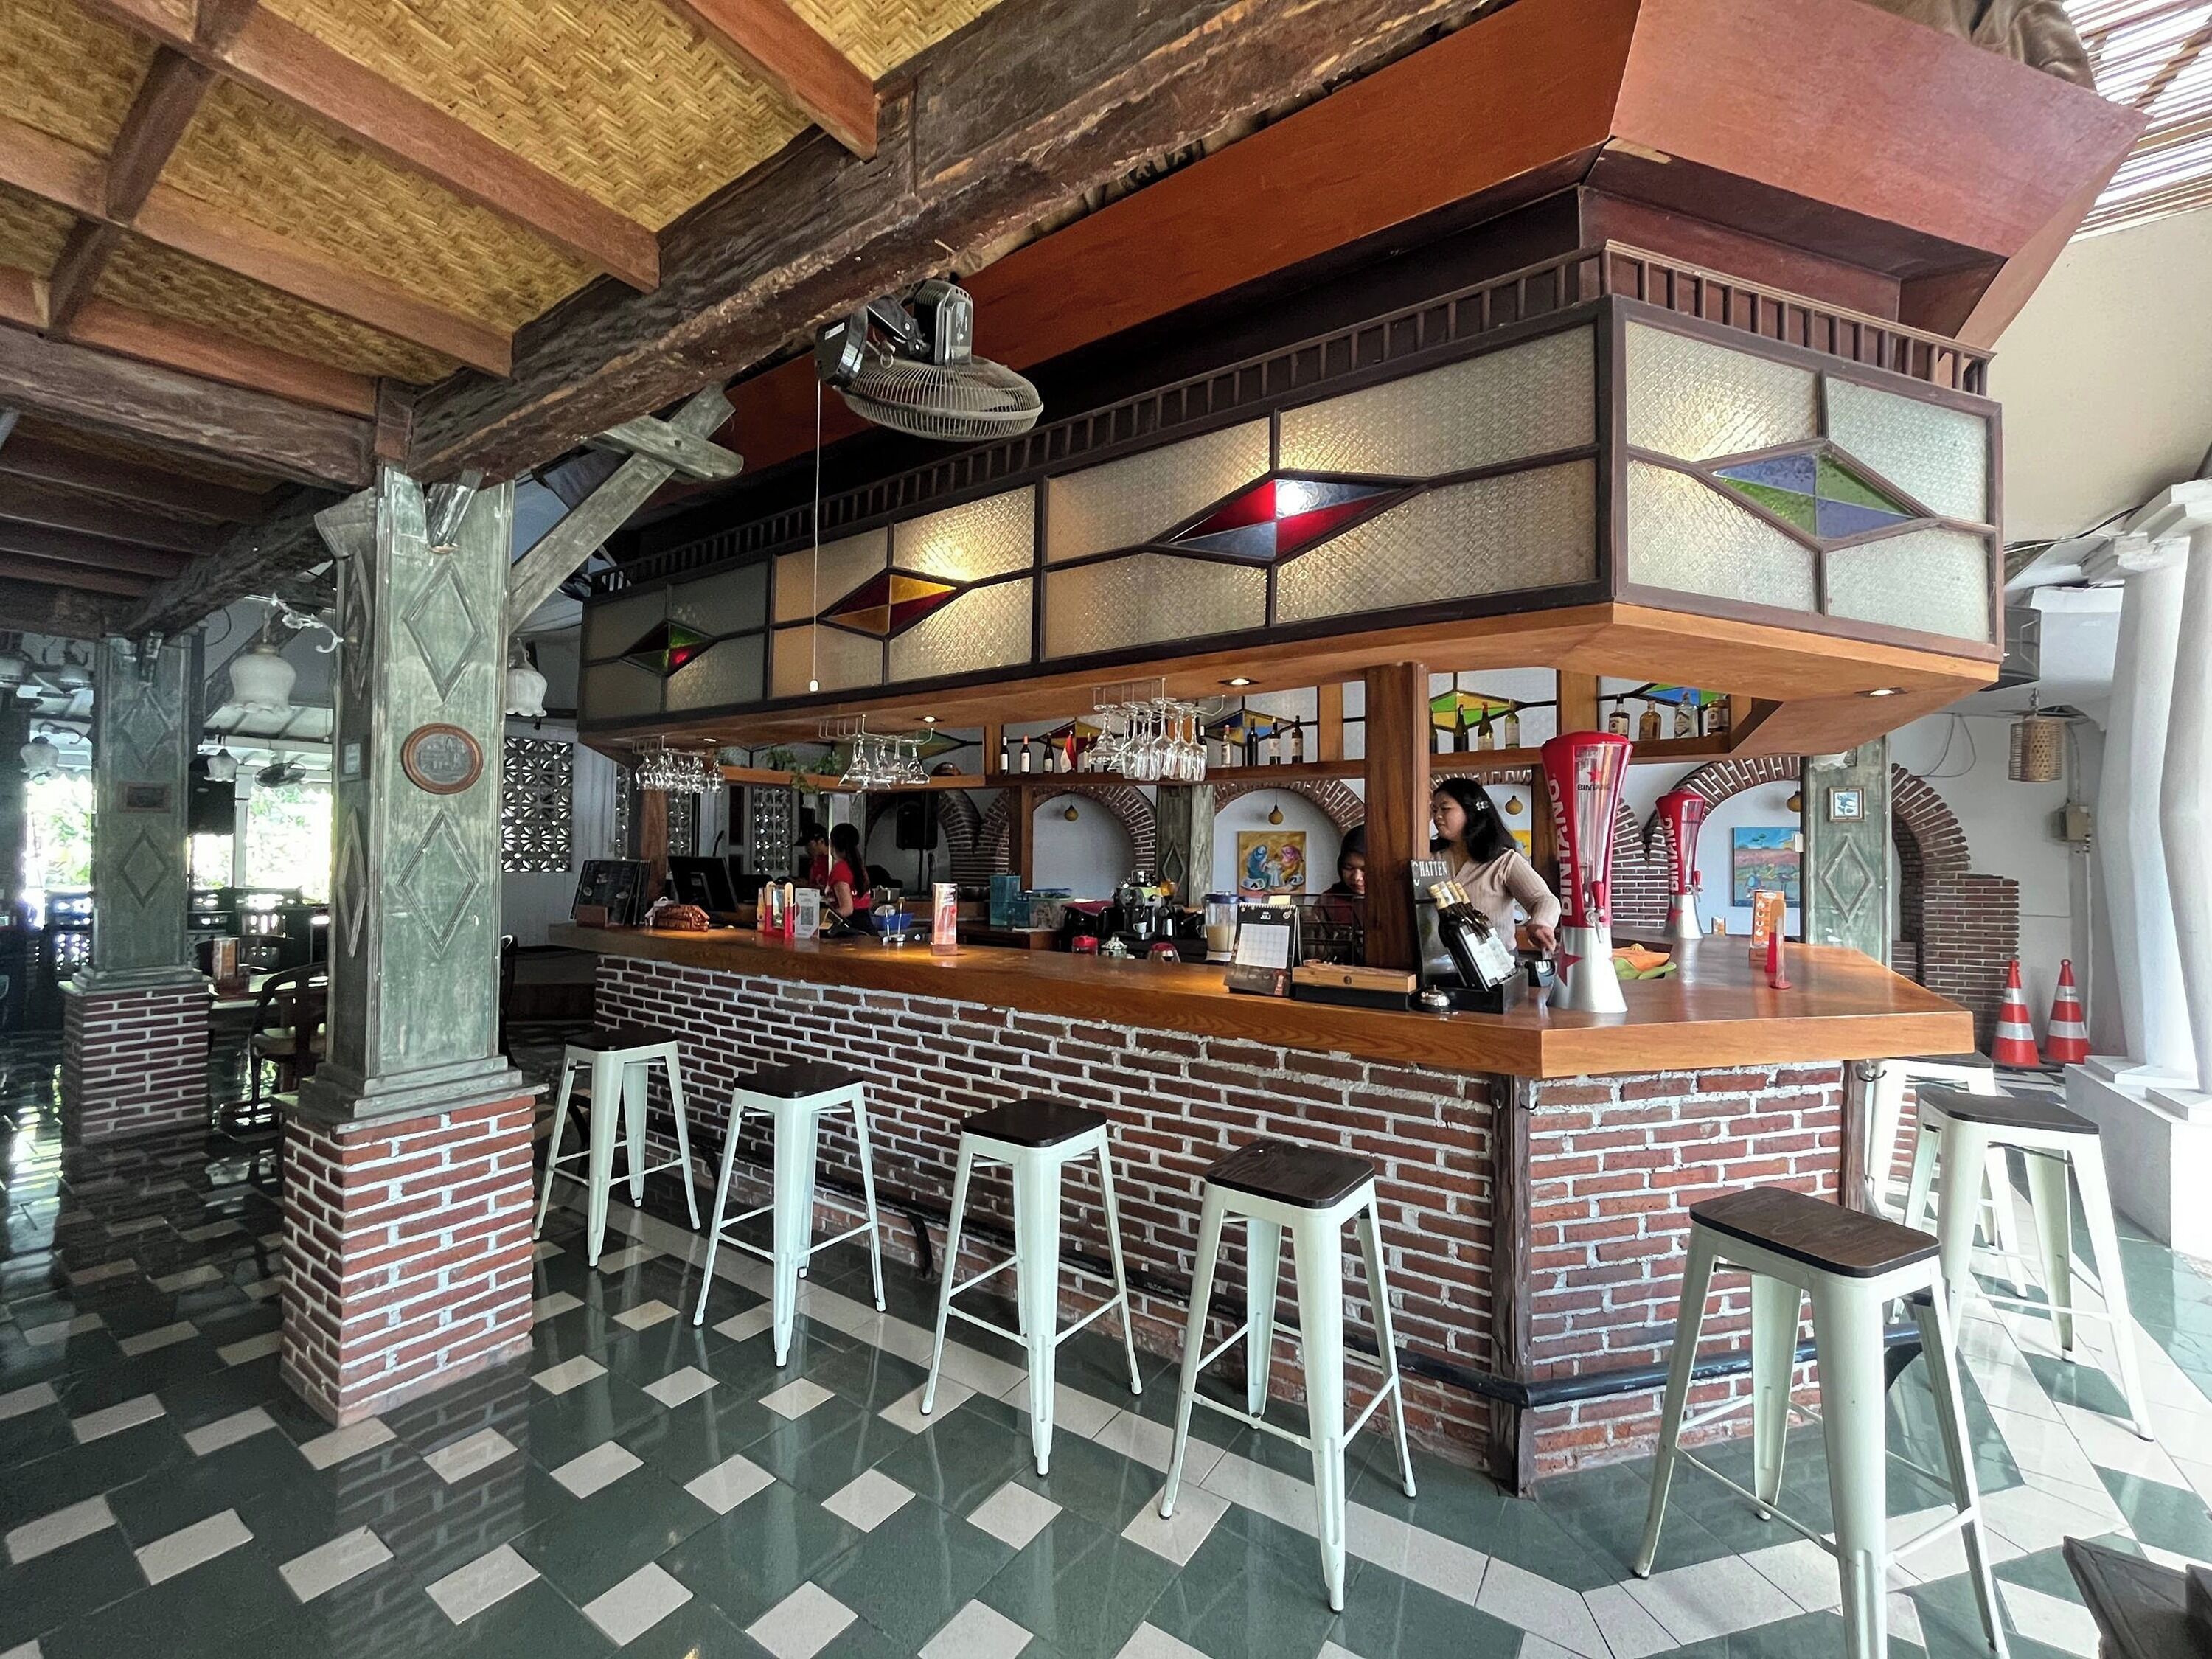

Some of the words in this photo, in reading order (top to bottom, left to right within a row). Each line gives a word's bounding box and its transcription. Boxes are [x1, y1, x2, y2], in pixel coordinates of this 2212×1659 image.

[1419, 860, 1448, 877] HATTEN
[1549, 778, 1573, 917] BINTANG
[1664, 816, 1679, 891] BINTANG
